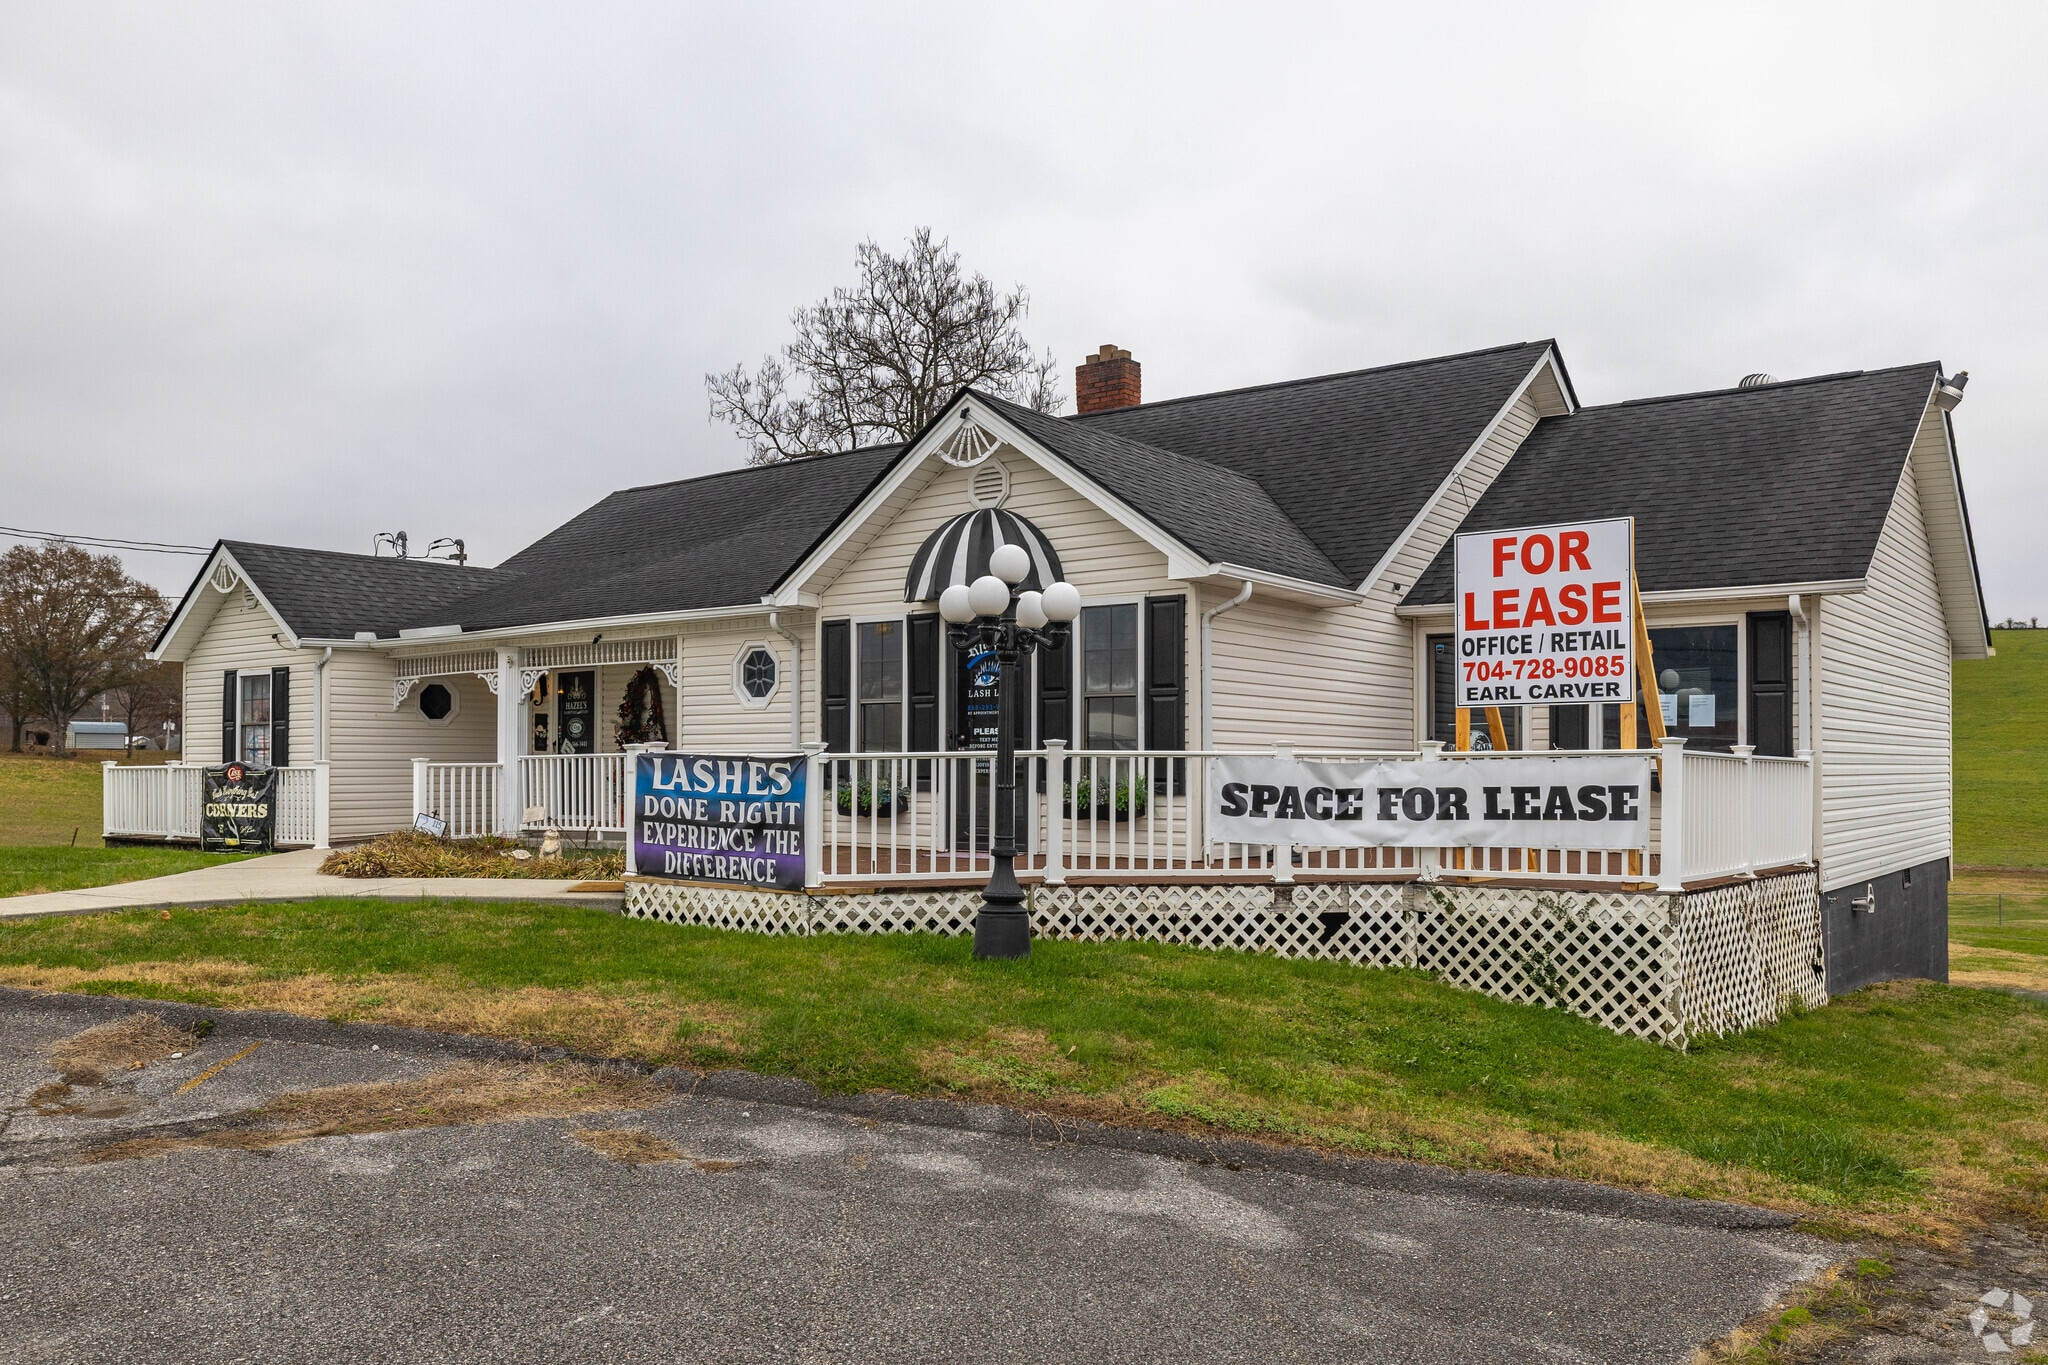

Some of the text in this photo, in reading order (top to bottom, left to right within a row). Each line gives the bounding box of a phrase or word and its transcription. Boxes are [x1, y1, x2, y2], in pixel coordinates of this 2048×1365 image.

[1493, 530, 1592, 578] FOR
[1464, 581, 1622, 631] LEASE
[1461, 629, 1626, 657] OFFICE / RETAIL
[1463, 655, 1625, 682] 704-728-9085
[968, 689, 991, 698] LASH
[1466, 682, 1621, 701] EARL CARVER
[973, 727, 999, 736] PLEAS
[652, 757, 792, 796] LASHES
[206, 803, 268, 818] CORNERS
[644, 795, 800, 825] DONE RIGHT
[1220, 782, 1639, 821] SPACE FOR LEASE
[643, 821, 800, 855] EXPERIENCE THE
[664, 850, 777, 883] DIFFERENCE
